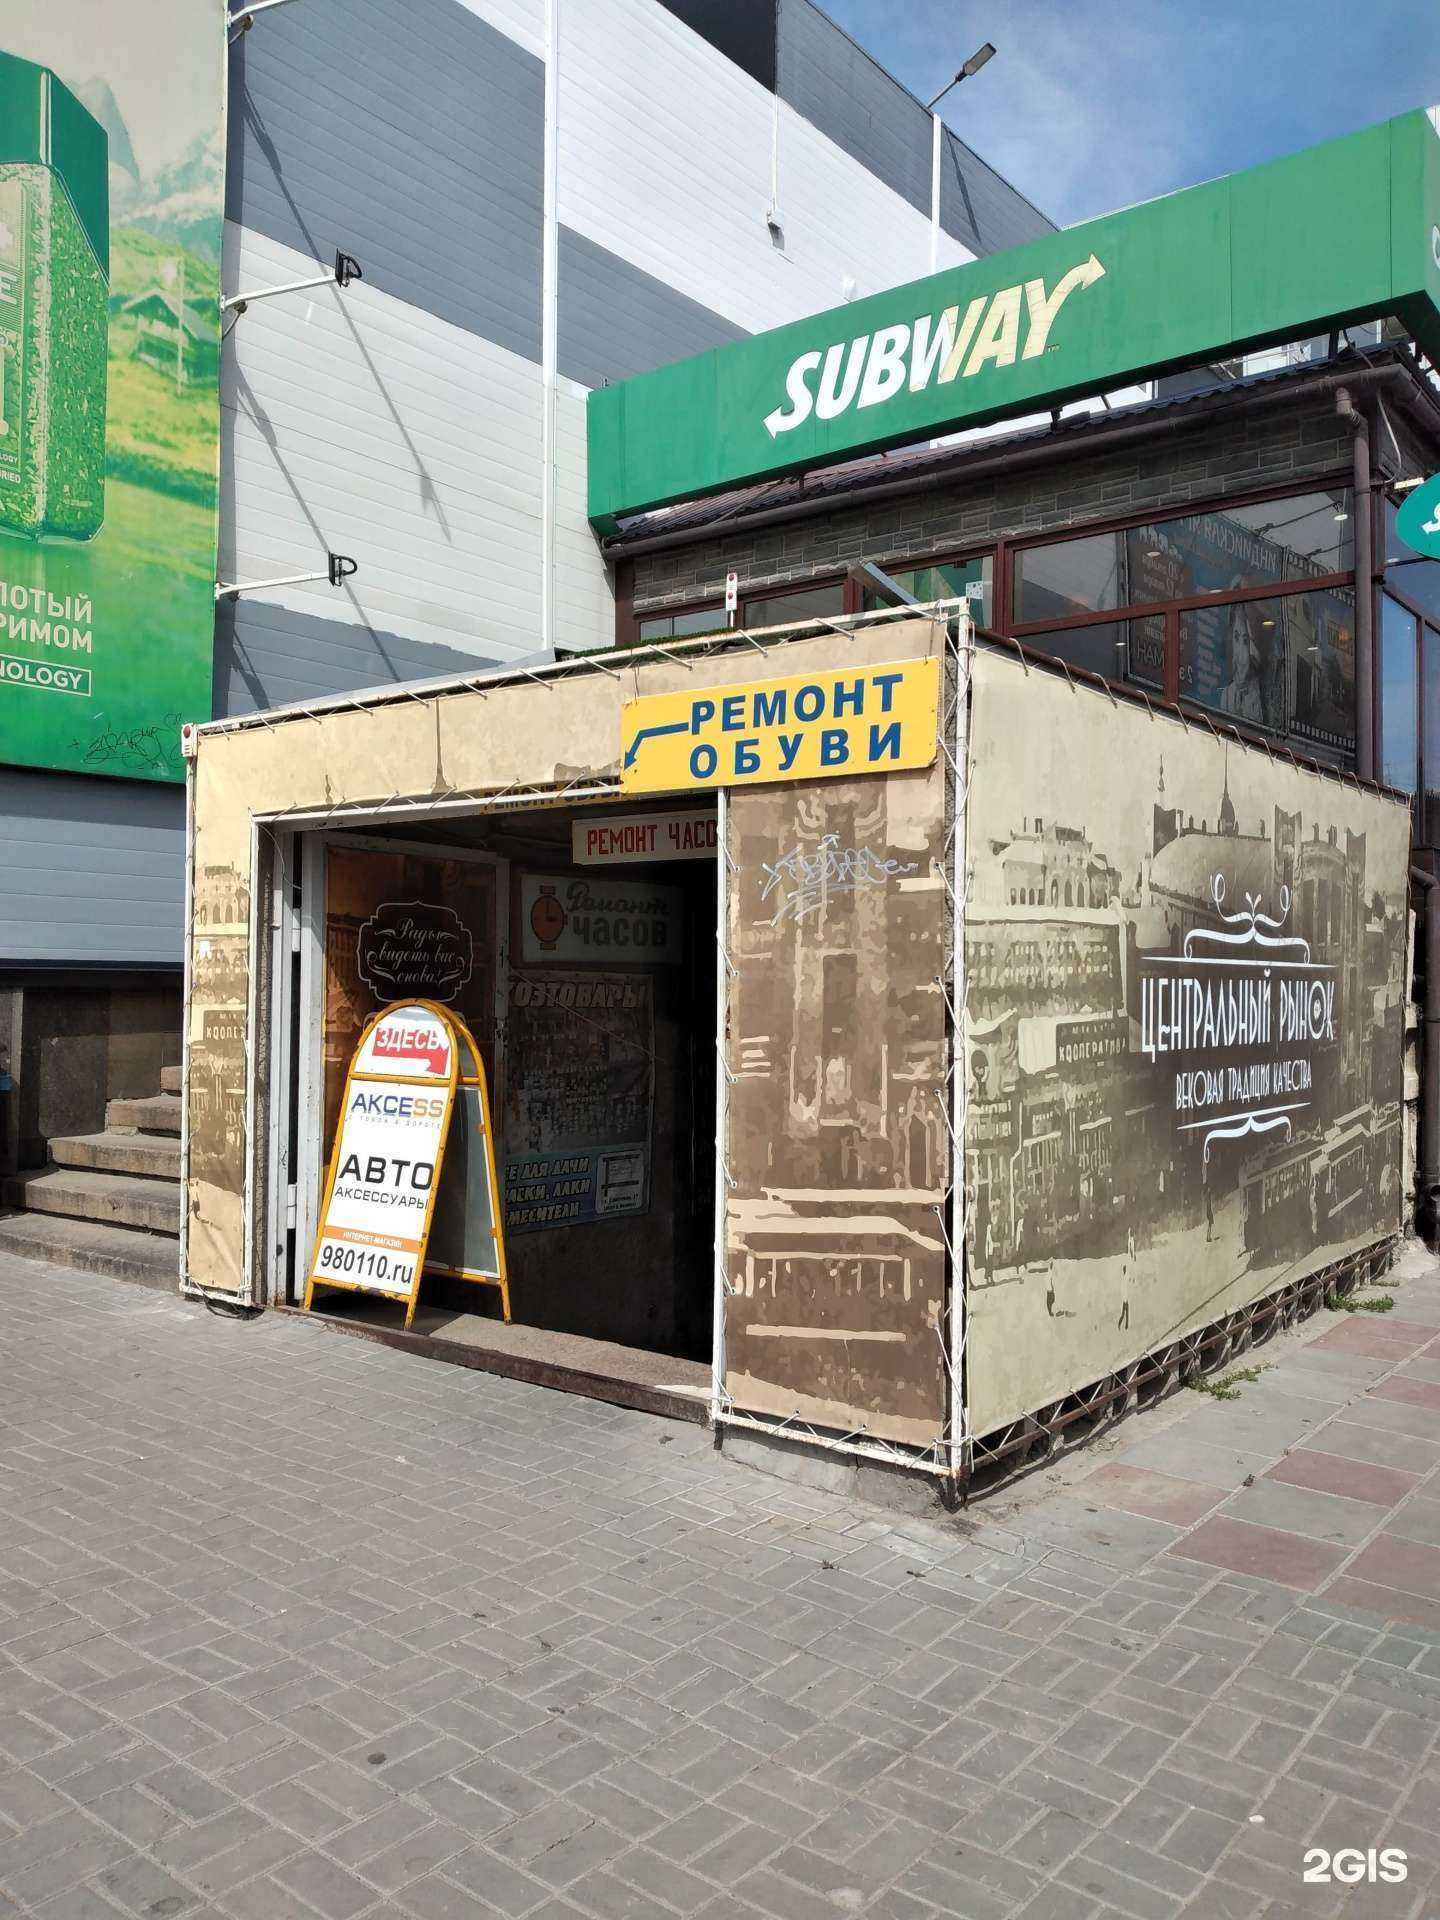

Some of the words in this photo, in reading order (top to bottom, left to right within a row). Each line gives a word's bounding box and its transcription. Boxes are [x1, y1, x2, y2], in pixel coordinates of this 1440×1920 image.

[762, 253, 1106, 440] SUBWAY
[690, 672, 904, 736] РЕМОНТ
[688, 721, 902, 779] ОБУВИ
[587, 825, 658, 856] РЕМОНТ
[1141, 968, 1271, 1064] ЦЕНТРАЛЬНЫЙ
[1279, 980, 1335, 1042] РЫНОК
[376, 1027, 441, 1049] ЗДЕСЬ
[1176, 1068, 1224, 1110] ВЕКОВАЯ
[1228, 1062, 1270, 1103] ТРАДИЦИЯ
[1273, 1059, 1312, 1095] КАЧЕСТВА
[338, 1153, 434, 1191] АВТО
[520, 1160, 549, 1180] ДЛЯ
[553, 1178, 593, 1197] ЛАКИ
[334, 1186, 428, 1209] АКСЕССУАРЫ
[320, 1244, 414, 1284] 980110.ru
